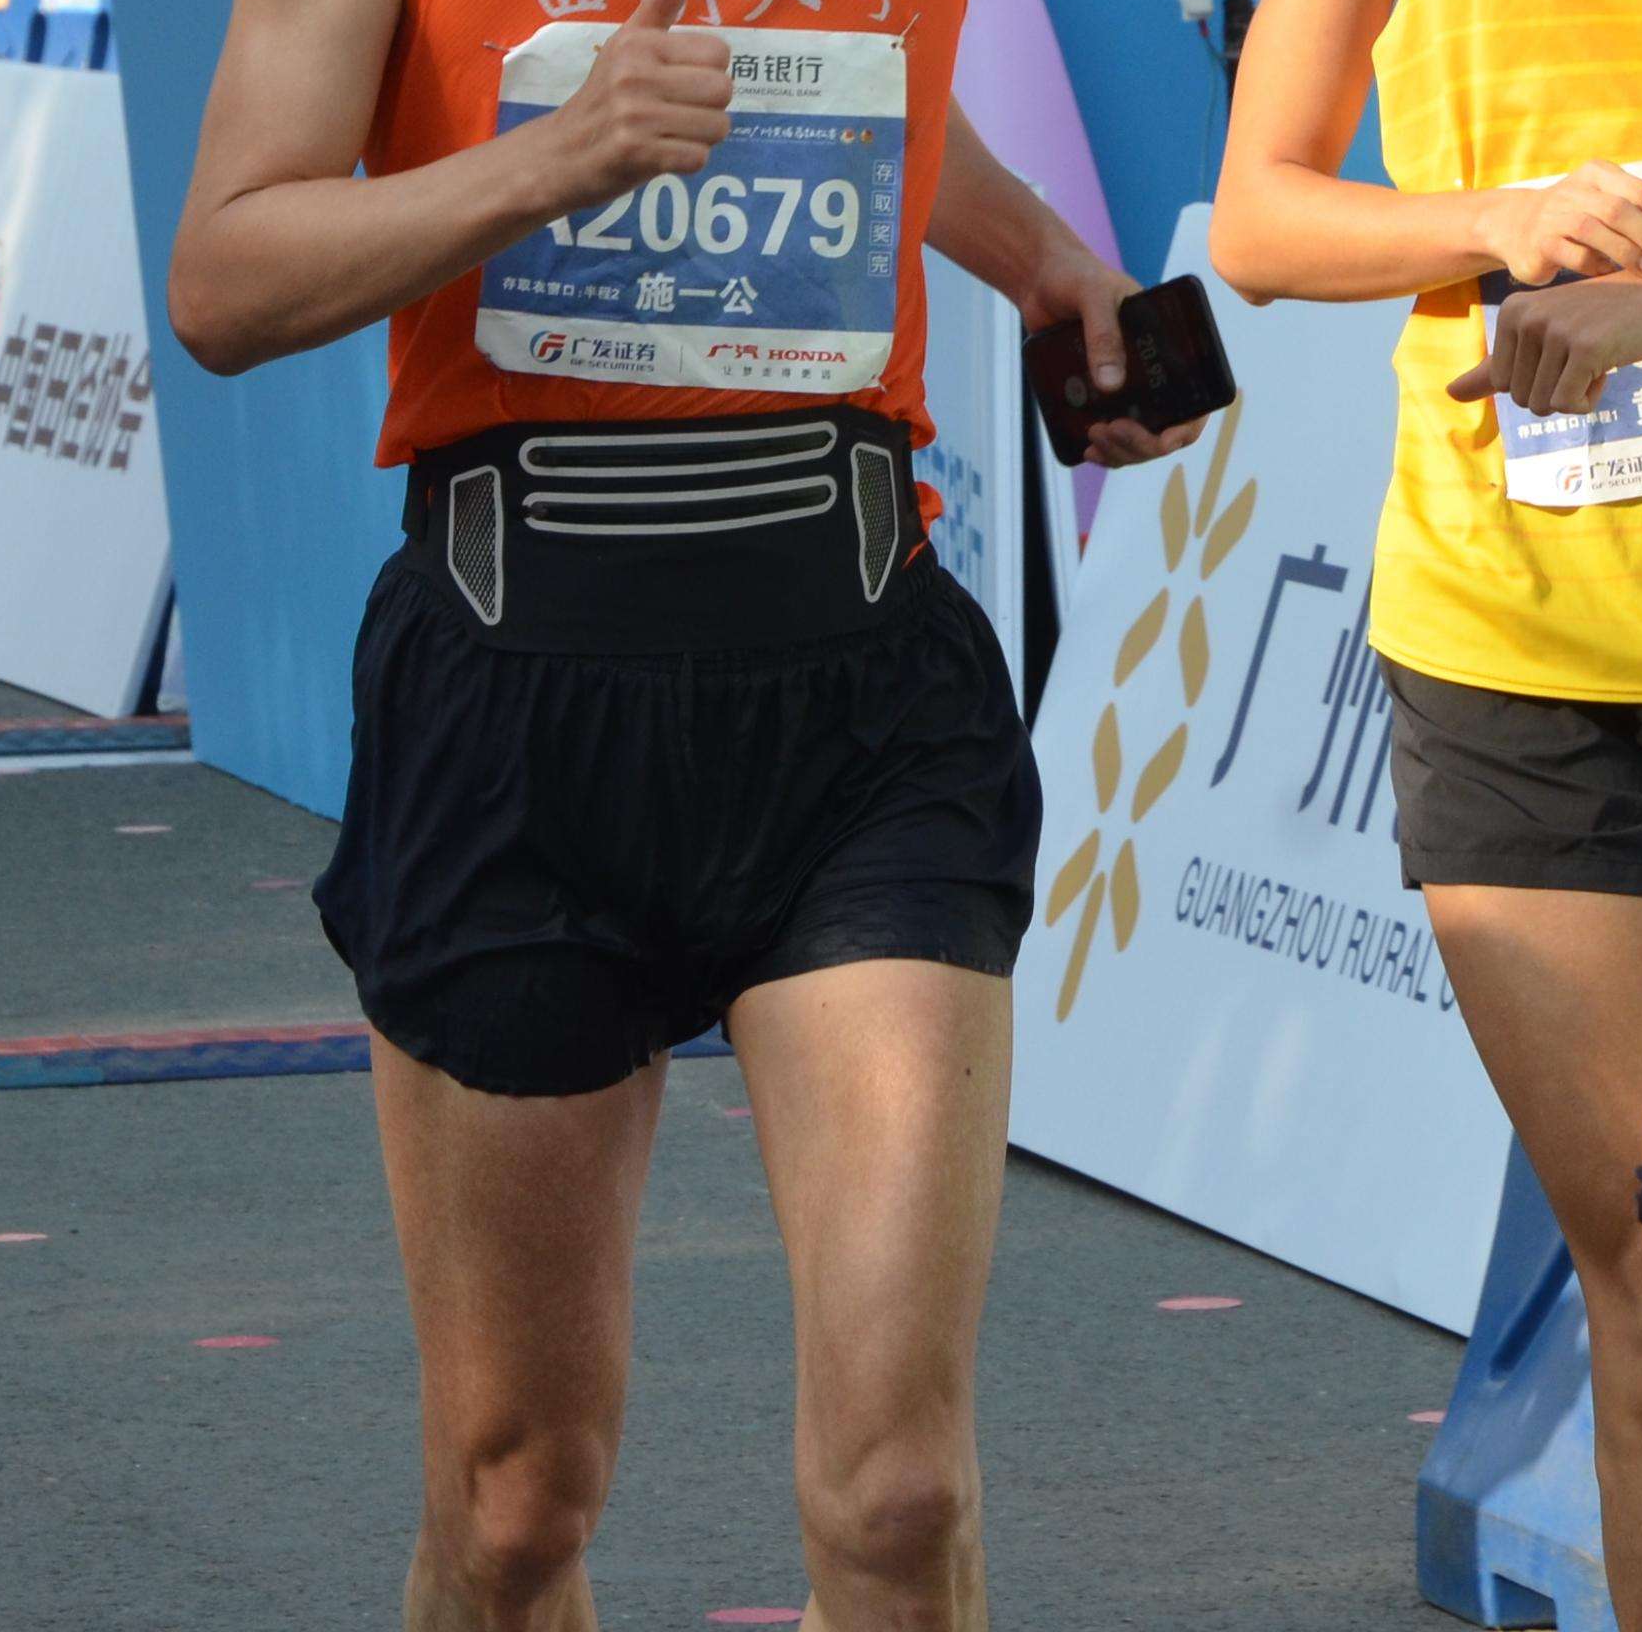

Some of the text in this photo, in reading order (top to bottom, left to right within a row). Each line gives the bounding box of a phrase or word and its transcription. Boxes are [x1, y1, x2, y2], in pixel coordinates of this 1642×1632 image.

[731, 55, 824, 84] 商银行
[547, 174, 859, 258] 20679
[636, 272, 757, 315] 施一公
[571, 338, 655, 361] 广发证券
[707, 344, 847, 364] 广汽 HONDA
[1176, 855, 1433, 1006] GUANGZHOU RURAL
